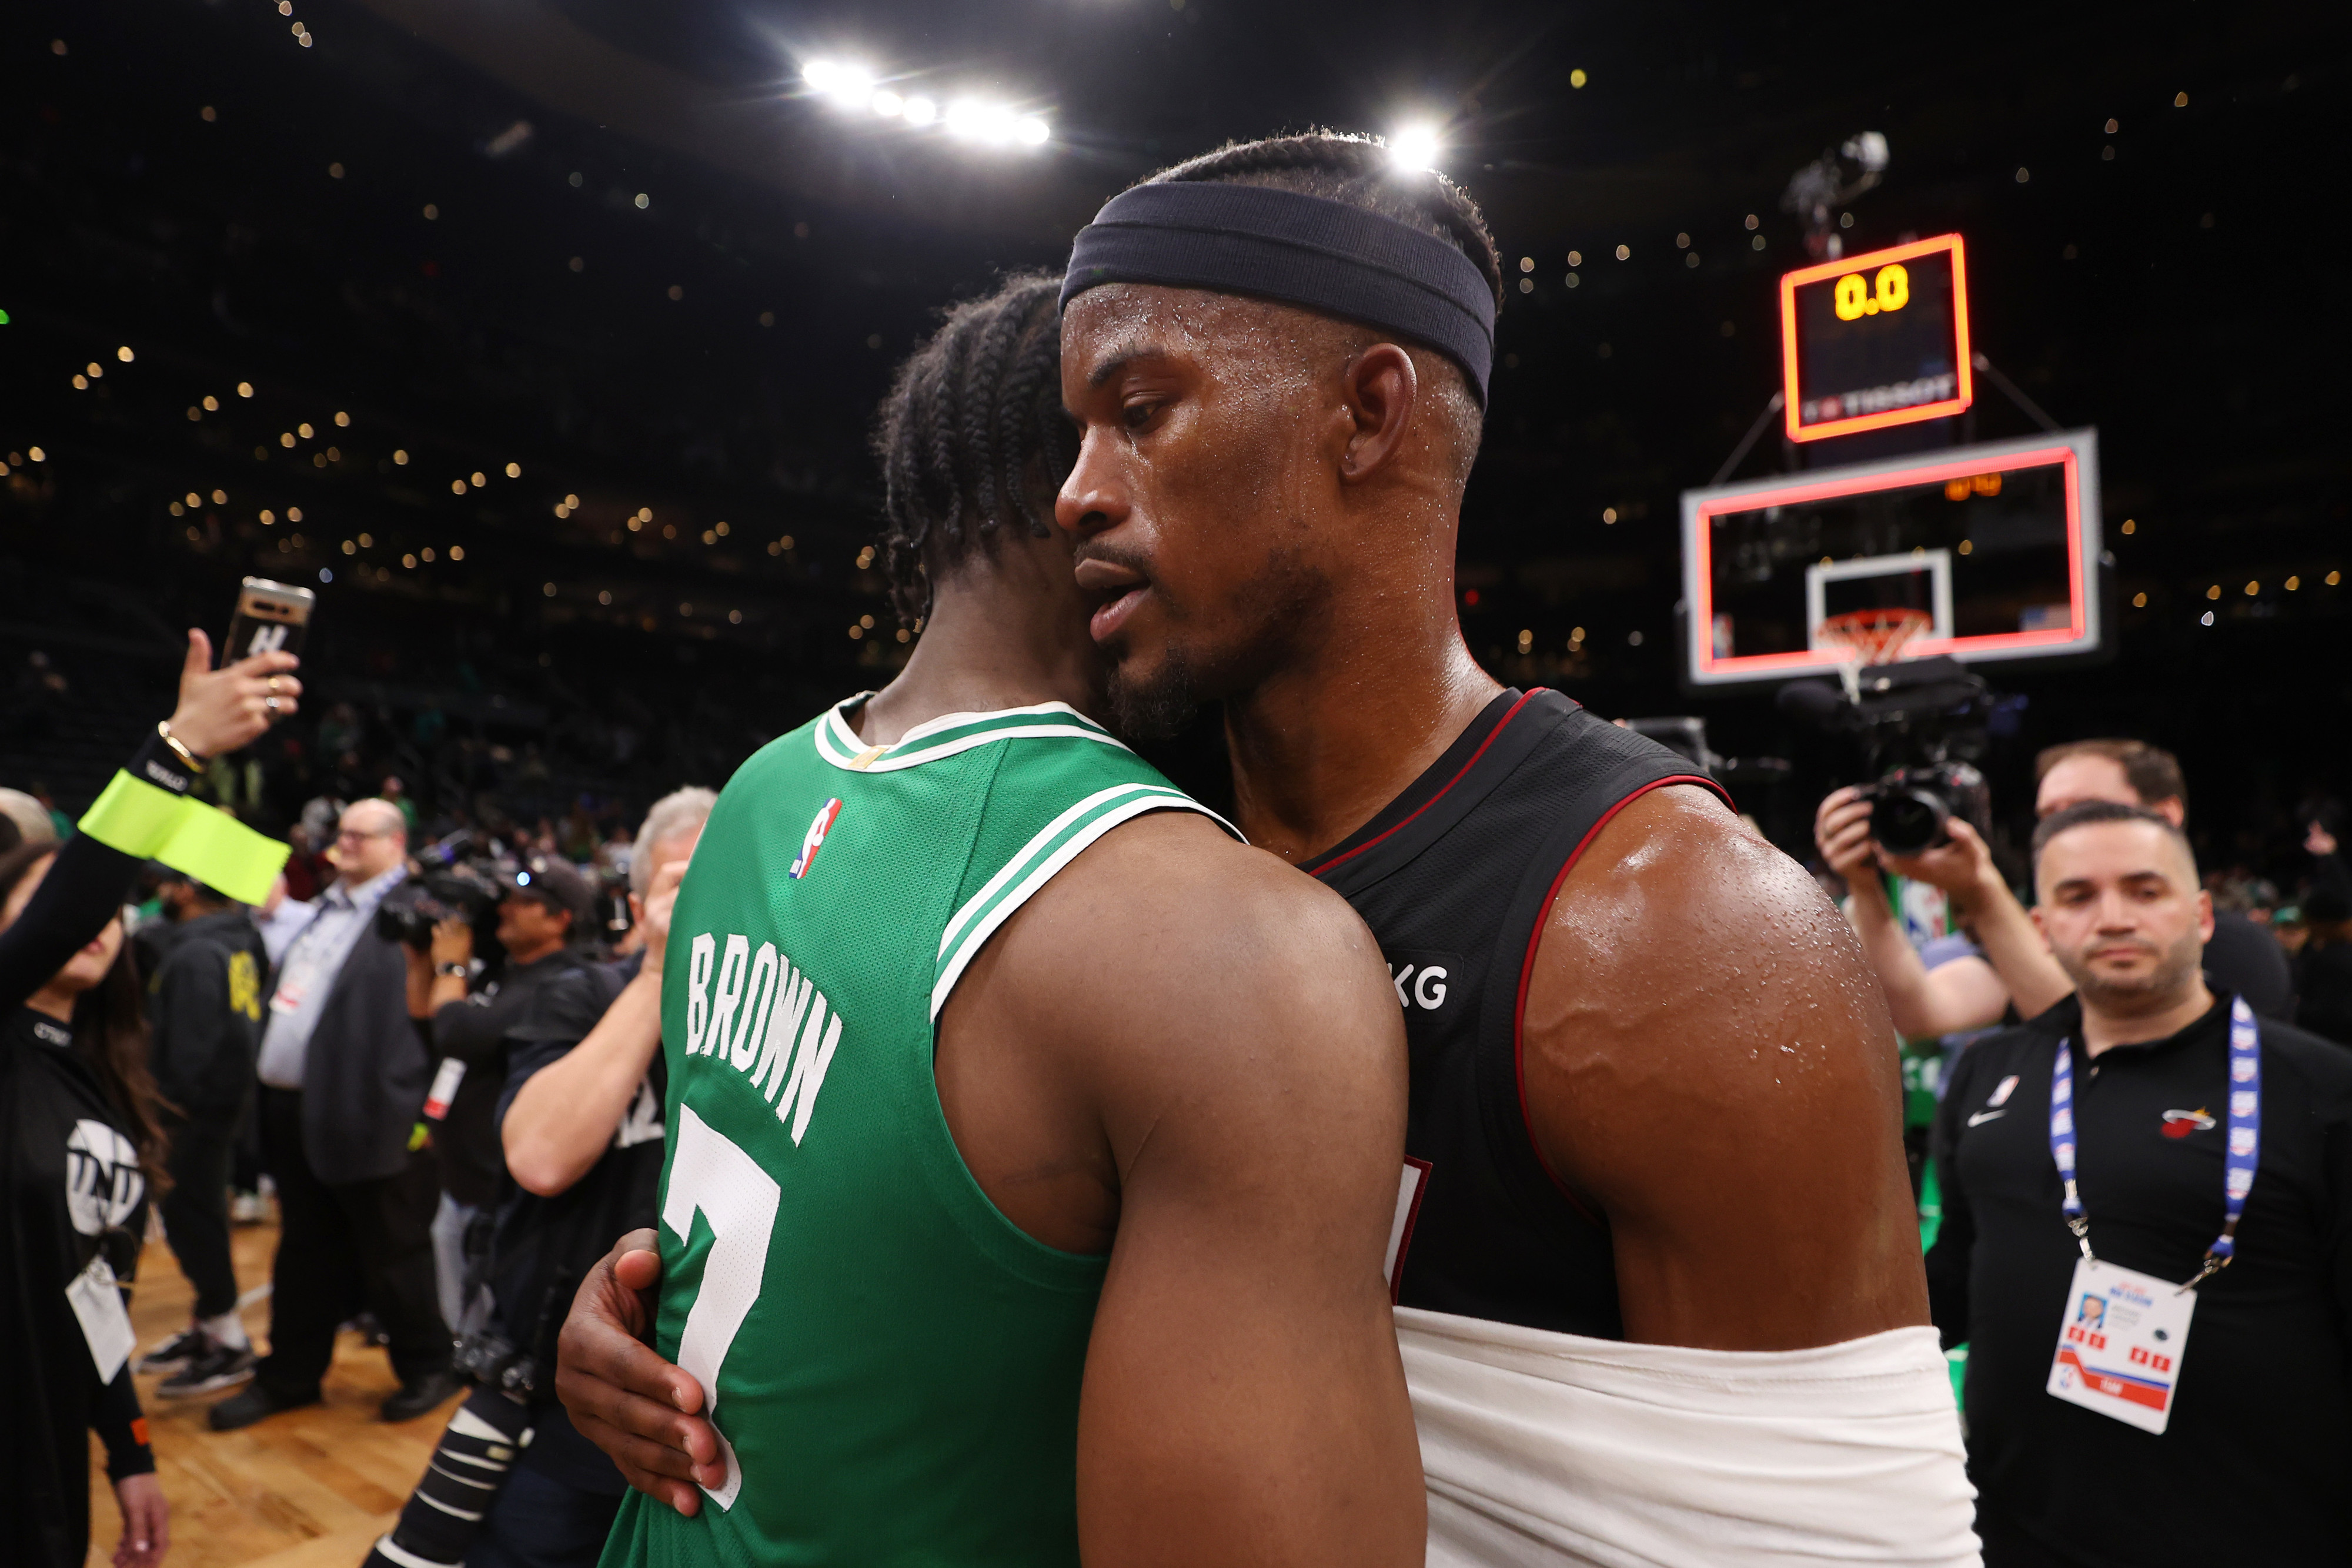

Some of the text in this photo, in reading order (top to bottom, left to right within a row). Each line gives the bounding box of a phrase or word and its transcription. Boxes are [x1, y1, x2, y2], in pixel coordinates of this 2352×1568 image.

[1835, 263, 1909, 321] 0.0
[686, 932, 843, 1148] BROWN
[662, 1102, 781, 1513] 7
